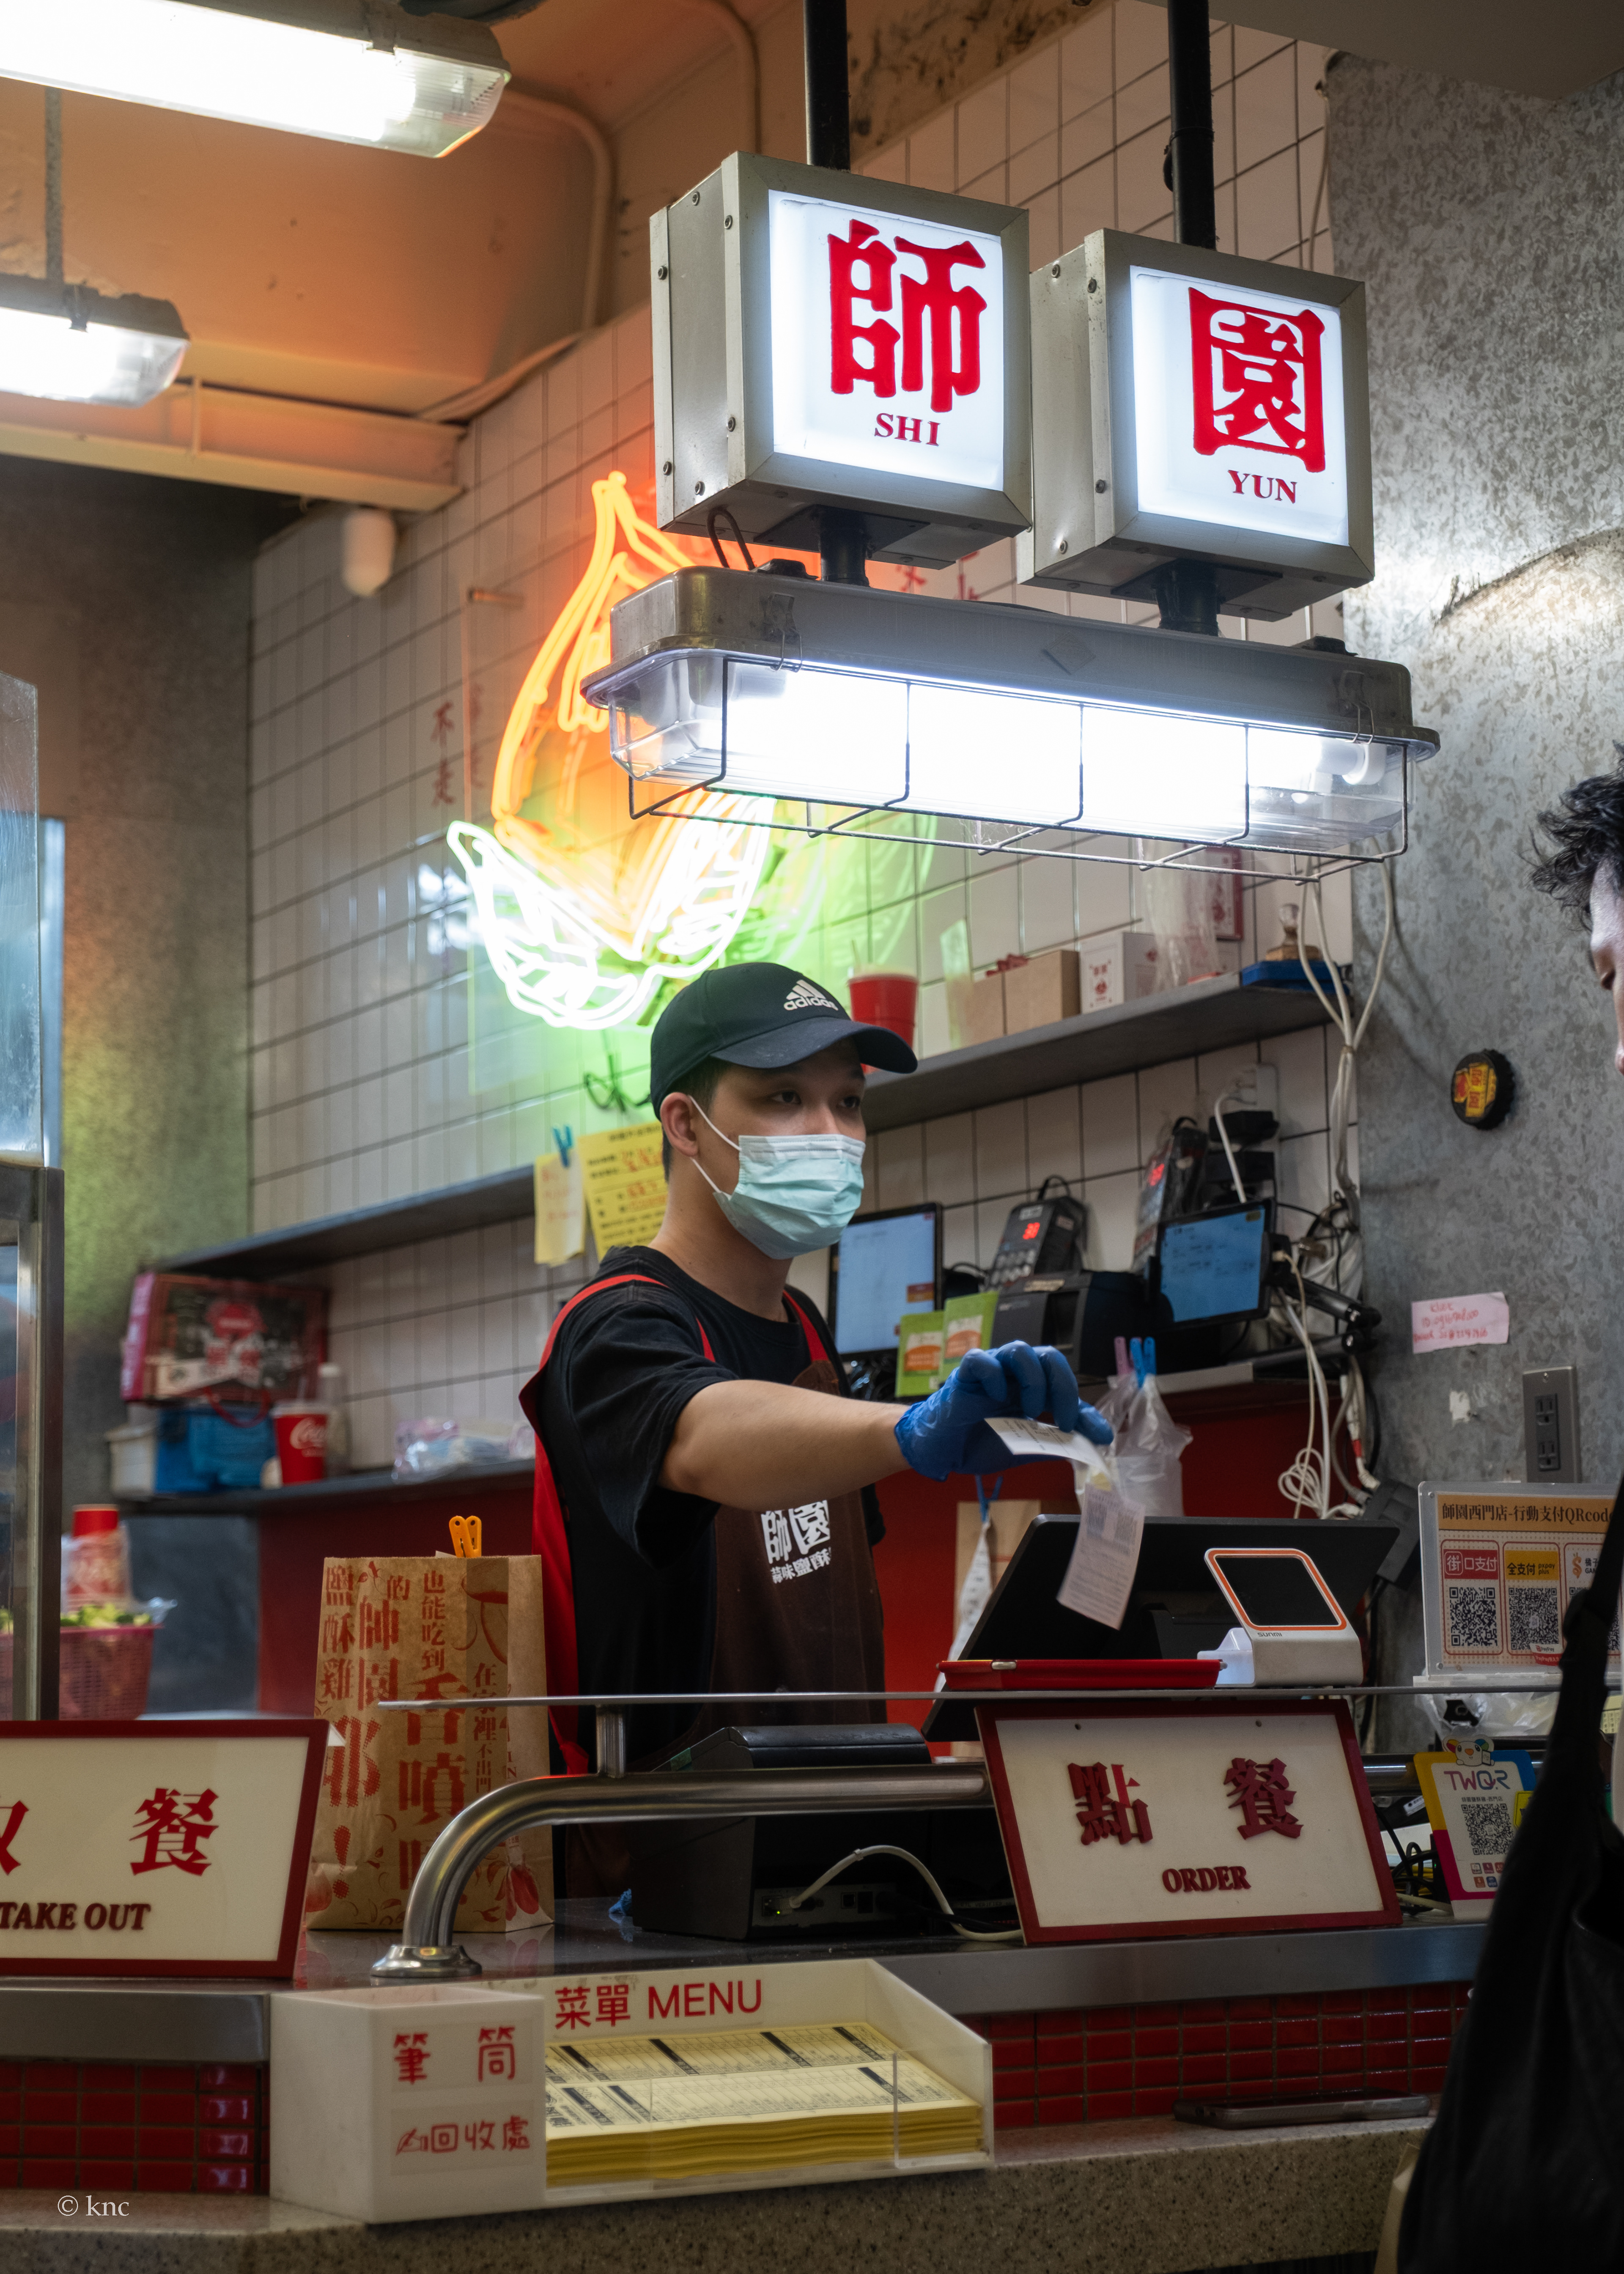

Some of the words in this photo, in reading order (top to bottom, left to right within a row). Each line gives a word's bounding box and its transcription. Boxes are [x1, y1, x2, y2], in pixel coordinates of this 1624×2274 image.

[828, 219, 987, 413] 師
[1189, 287, 1326, 473] 園
[874, 412, 940, 447] SHI
[1229, 470, 1298, 504] YUN
[784, 996, 839, 1011] adidas
[770, 1546, 832, 1584] 蒜味鹽酥
[1446, 1555, 1498, 1572] 街口支付
[1507, 1563, 1535, 1576] 全支付
[422, 1570, 446, 1672] 也能吃到
[1161, 1865, 1251, 1893] ORDER
[0, 1902, 77, 1930] TAKE
[84, 1903, 152, 1931] OUT
[554, 1984, 631, 2030] 菜單
[648, 1980, 762, 2020] MENU
[431, 2116, 530, 2153] 回收處
